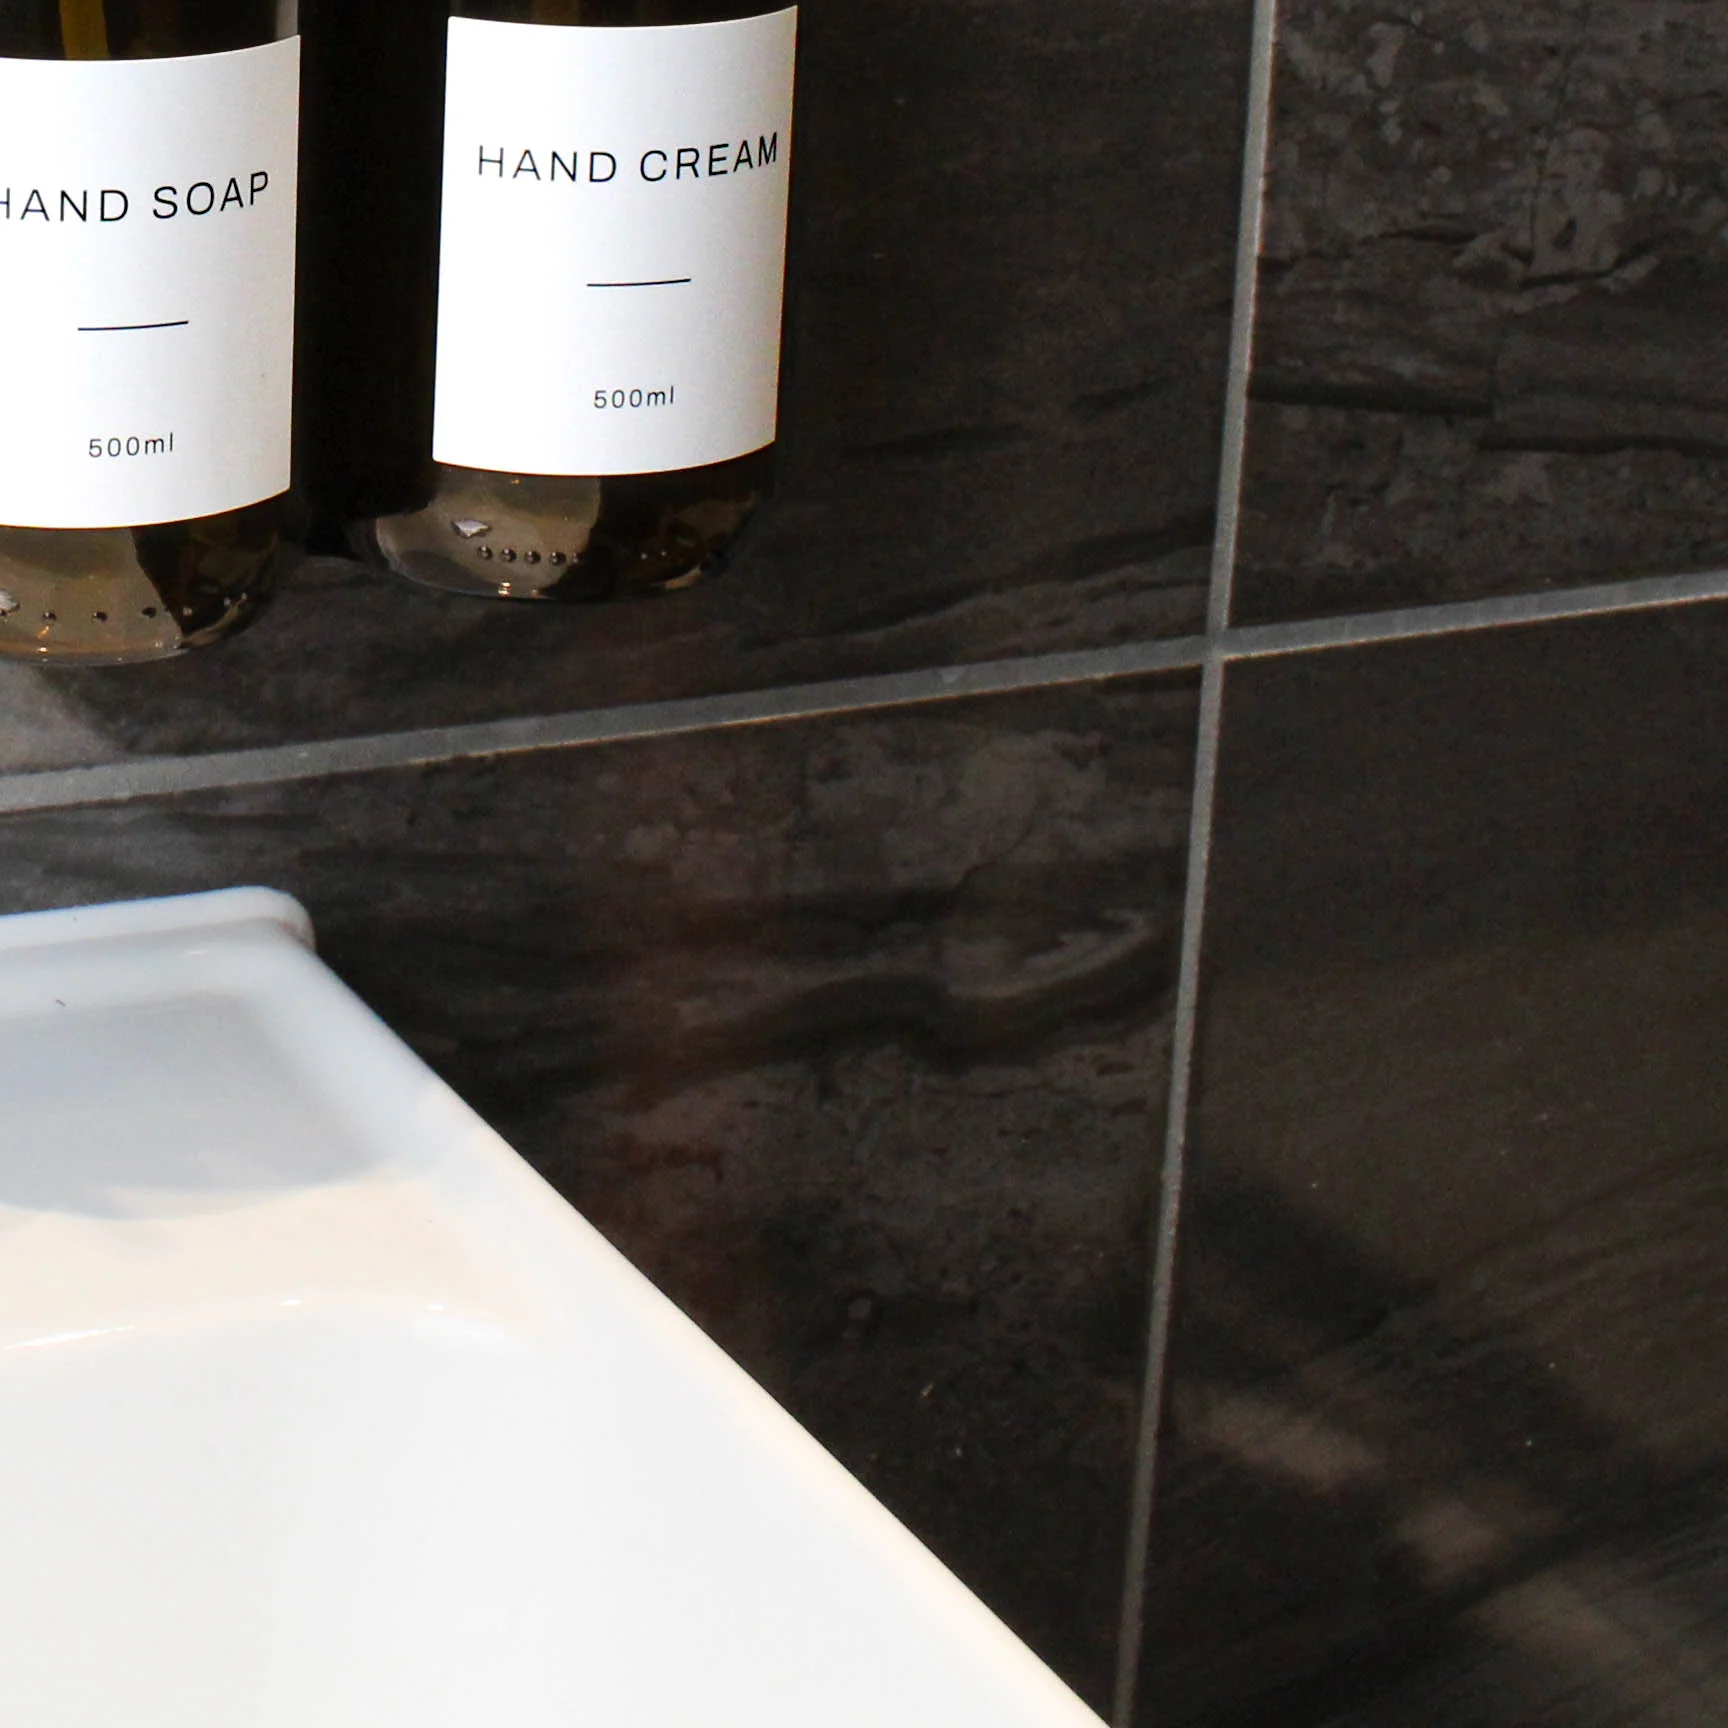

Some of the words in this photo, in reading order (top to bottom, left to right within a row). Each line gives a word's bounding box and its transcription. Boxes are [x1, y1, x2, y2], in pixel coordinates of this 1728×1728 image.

[478, 145, 617, 183] HAND
[639, 131, 778, 182] CREAM
[152, 170, 269, 220] SOAP
[594, 385, 674, 409] 500ml
[89, 432, 174, 458] 500ml
